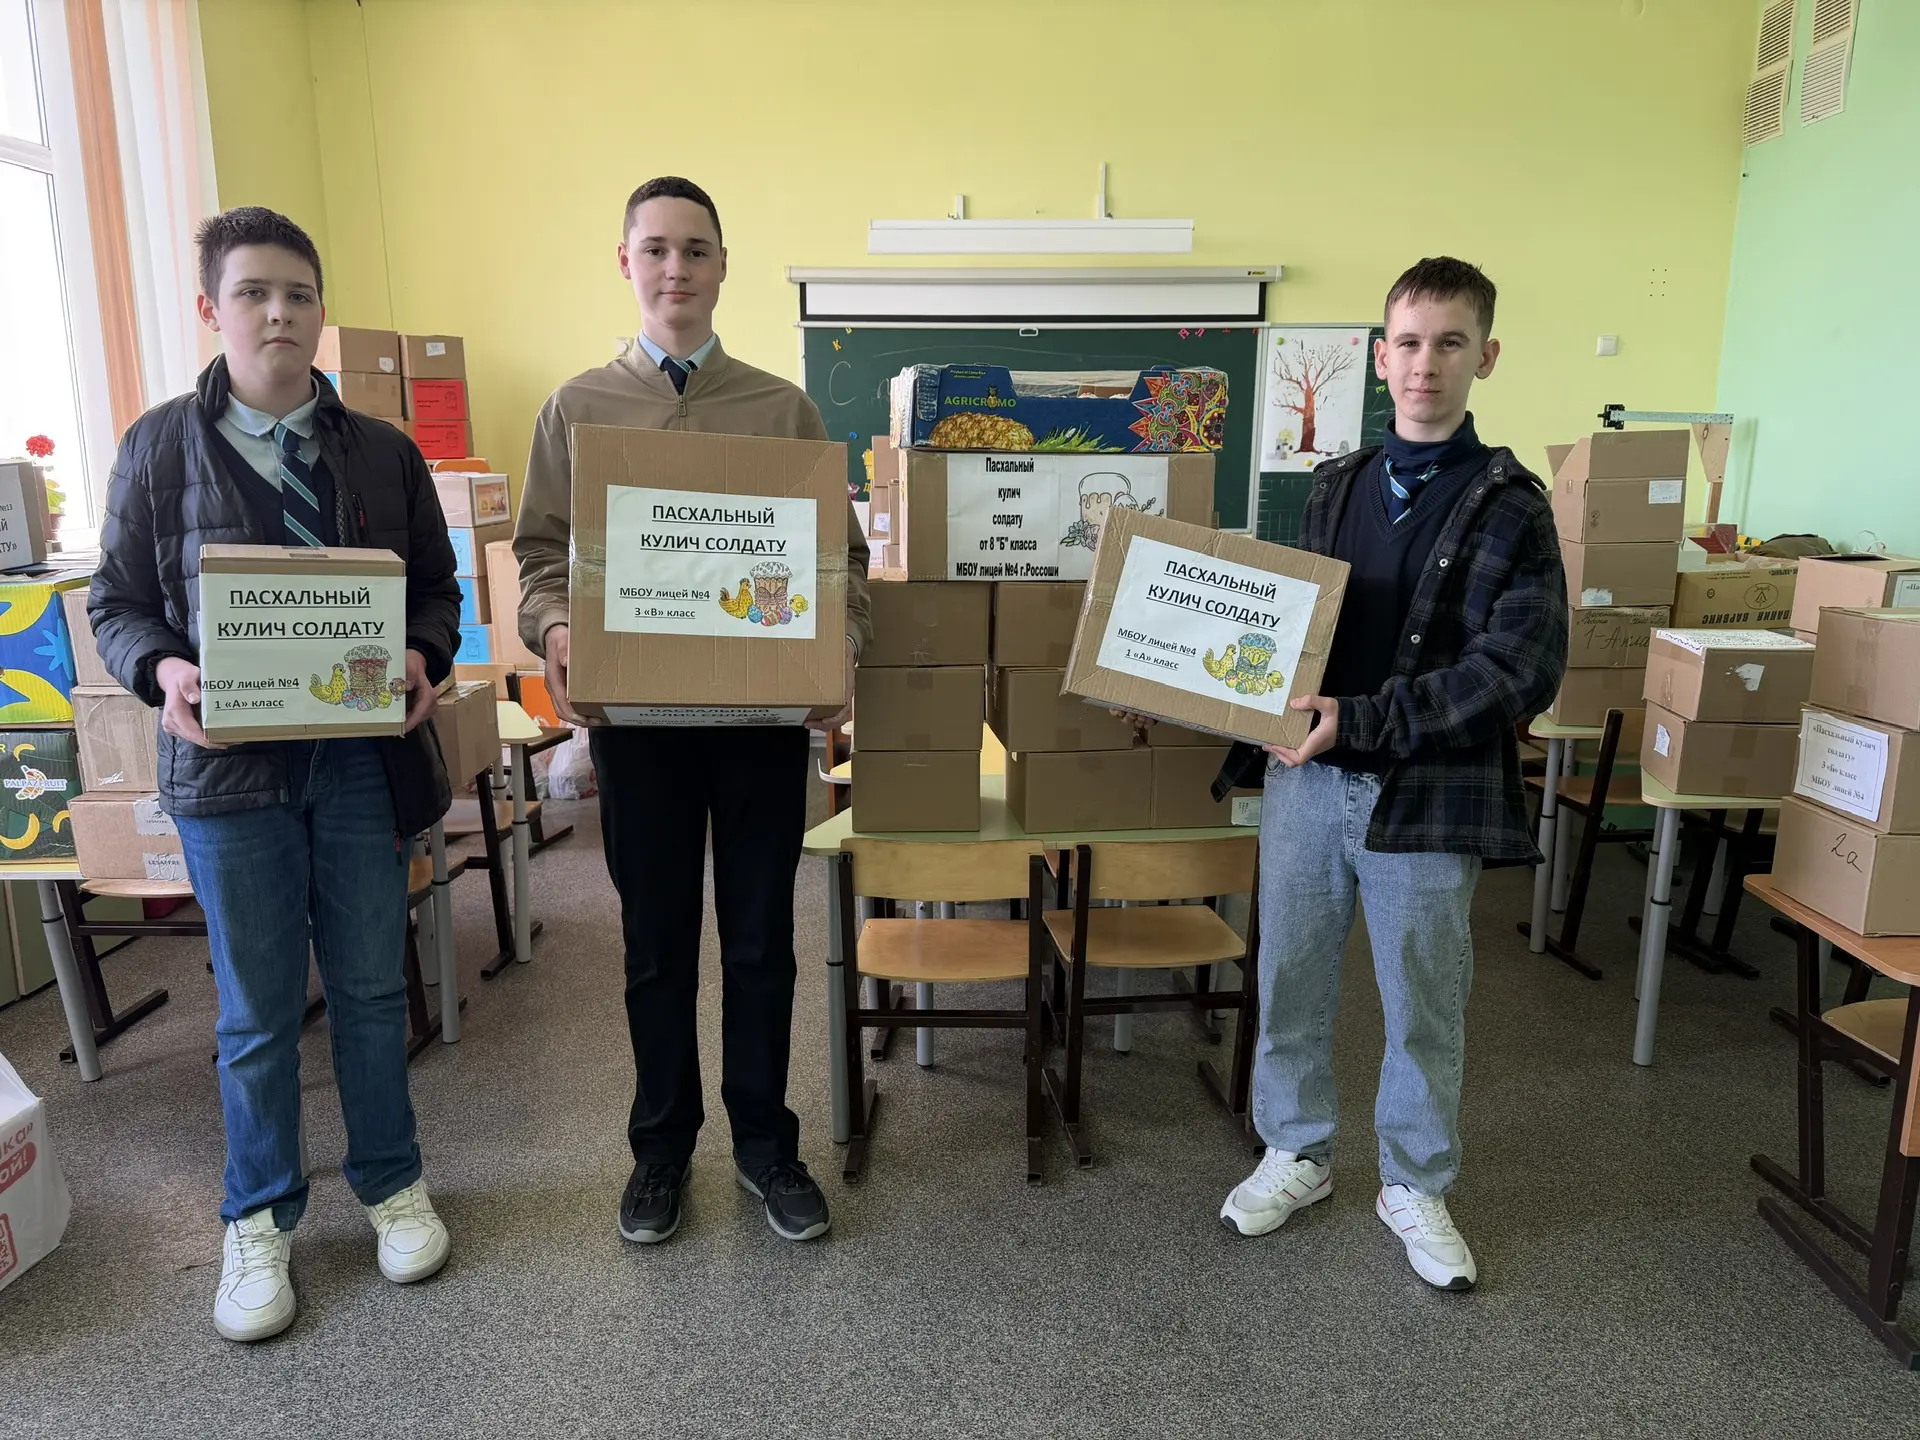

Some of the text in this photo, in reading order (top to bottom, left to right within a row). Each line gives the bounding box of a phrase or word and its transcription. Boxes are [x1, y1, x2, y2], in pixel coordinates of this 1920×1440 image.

[985, 457, 1034, 473] Пасхальный
[998, 487, 1021, 502] кулич
[652, 504, 775, 525] ПАСХАЛЬНЫЙ
[992, 514, 1023, 528] солдату
[641, 534, 787, 555] КУЛИЧ СОЛДАТУ
[979, 536, 1037, 551] от 8 "Б" класса
[956, 562, 1059, 579] МБОУ лицей №4 г.Россоши
[1165, 560, 1277, 600] ПАСХАЛЬНЫЙ
[229, 586, 371, 605] ПАСХАЛЬНЫЙ
[620, 587, 710, 600] МБОУ лицей №4
[634, 607, 696, 618] 3 «В» класс
[1148, 584, 1281, 629] КУЛИЧ СОЛДАТУ
[218, 621, 385, 638] КУЛИЧ СОЛДАТУ
[1117, 627, 1197, 656] МБОУ лицей №4
[1125, 649, 1180, 670] 1 «А» класс
[237, 678, 275, 690] лицей
[278, 677, 300, 688] №4
[214, 699, 285, 709] 1 «А» класс
[1812, 724, 1876, 751] «Пасхальный кулич
[1827, 747, 1855, 762] солдату»
[1821, 760, 1826, 769] 3
[1839, 768, 1858, 781] класс
[1810, 774, 1865, 801] МБОУ лицей №4
